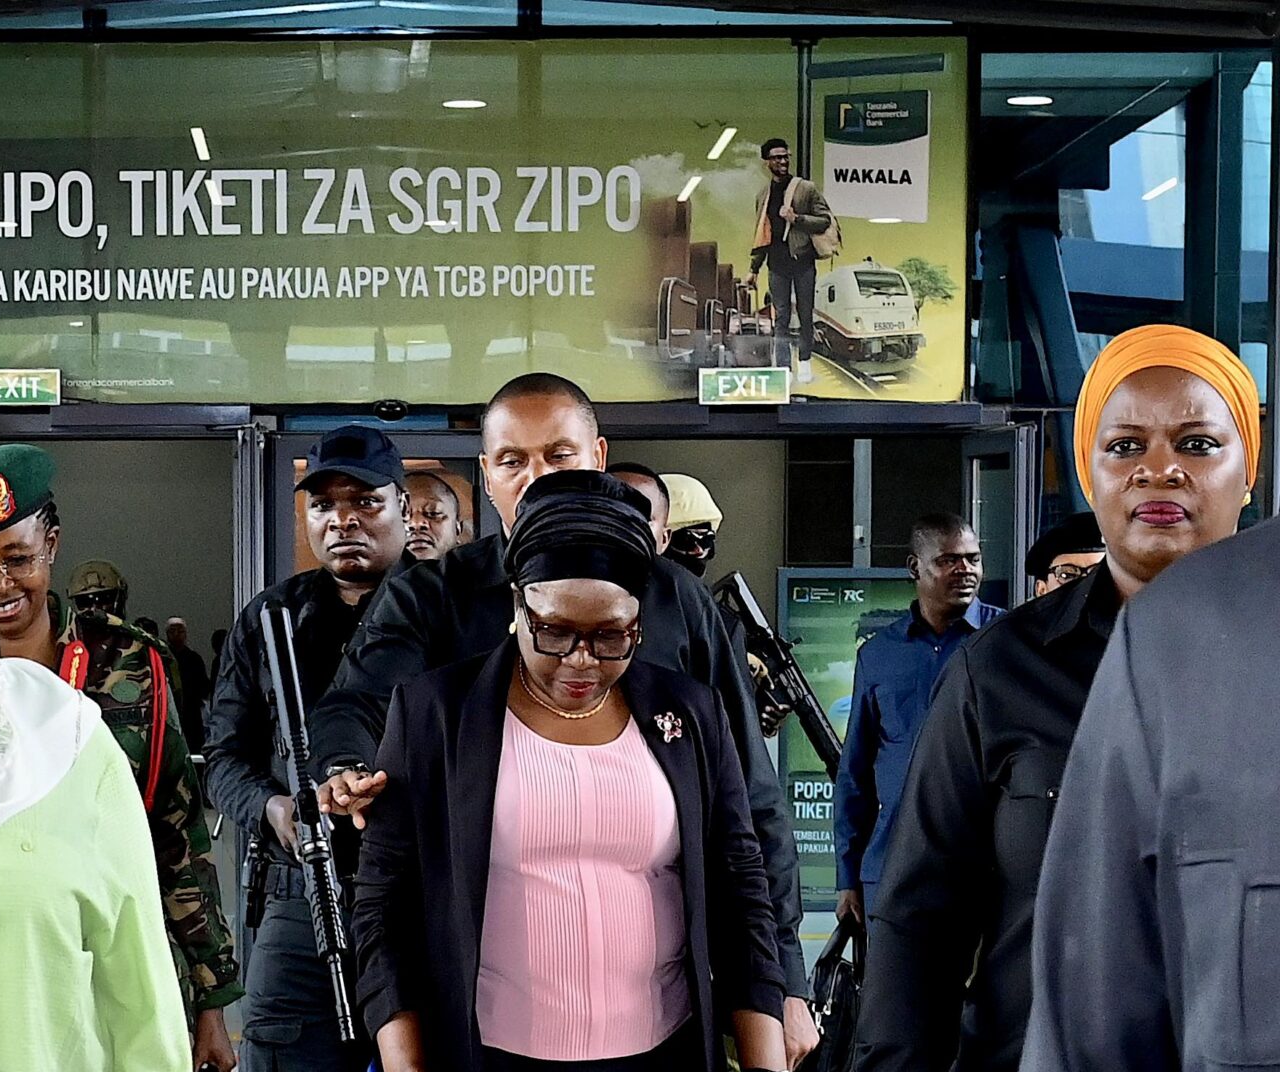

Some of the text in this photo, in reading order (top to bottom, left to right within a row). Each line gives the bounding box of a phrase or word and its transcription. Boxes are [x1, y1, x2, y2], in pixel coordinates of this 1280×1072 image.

[866, 102, 898, 110] Tanzania
[866, 110, 909, 119] Commercial
[866, 119, 883, 127] Bank
[833, 168, 913, 185] WAKALA
[119, 168, 288, 236] TIKETI
[302, 168, 375, 235] ZA
[387, 166, 502, 234] SGR
[514, 165, 641, 233] ZIPO
[13, 268, 111, 302] KARIBU
[117, 267, 194, 301] NAWE
[199, 267, 235, 300] AU
[241, 266, 331, 299] PAKUA
[335, 266, 389, 298] APP
[395, 265, 429, 298] YA
[433, 265, 486, 297] TCB
[493, 264, 595, 297] POPOTE
[718, 375, 770, 397] EXIT
[794, 781, 836, 799] POPO
[793, 830, 830, 841] TEMBELEA
[804, 843, 829, 853] PAKUA
